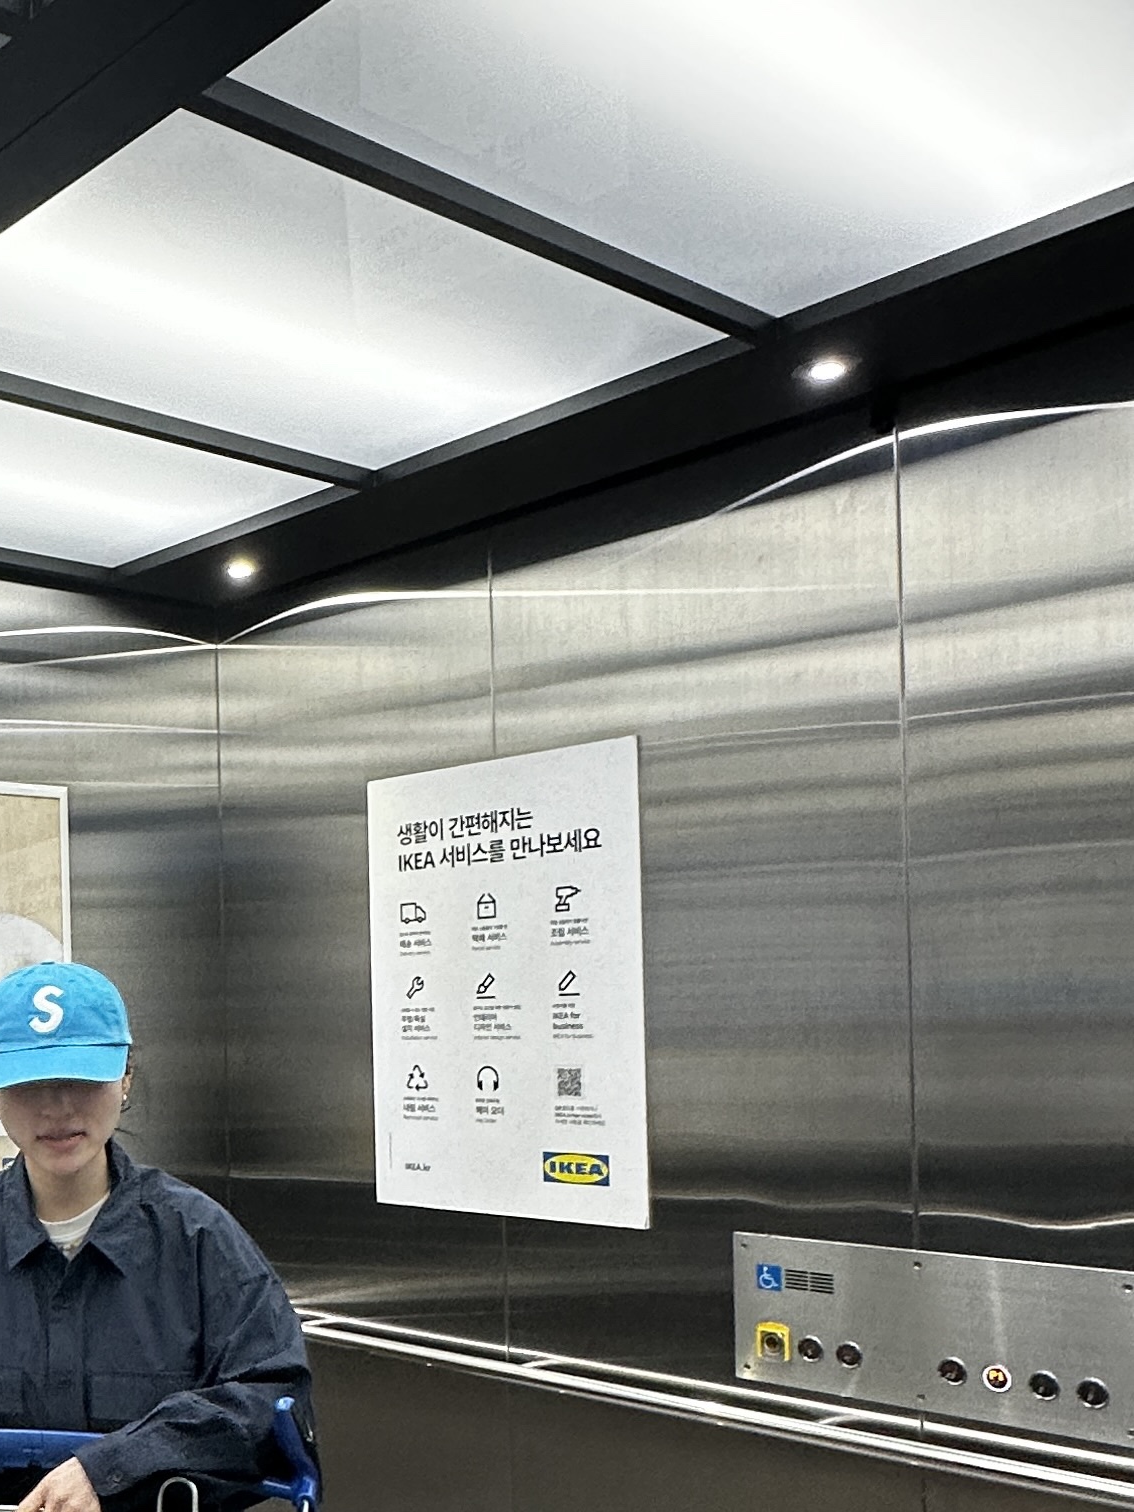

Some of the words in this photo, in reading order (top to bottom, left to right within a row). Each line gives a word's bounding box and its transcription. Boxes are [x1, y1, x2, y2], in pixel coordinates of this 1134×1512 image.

[397, 818, 444, 846] 생활이
[449, 807, 534, 839] 간편해지는
[398, 850, 436, 872] IKEA
[440, 839, 505, 868] 서비스를
[510, 827, 602, 860] 만나보세요
[28, 985, 64, 1033] S
[549, 1160, 605, 1177] IKEA
